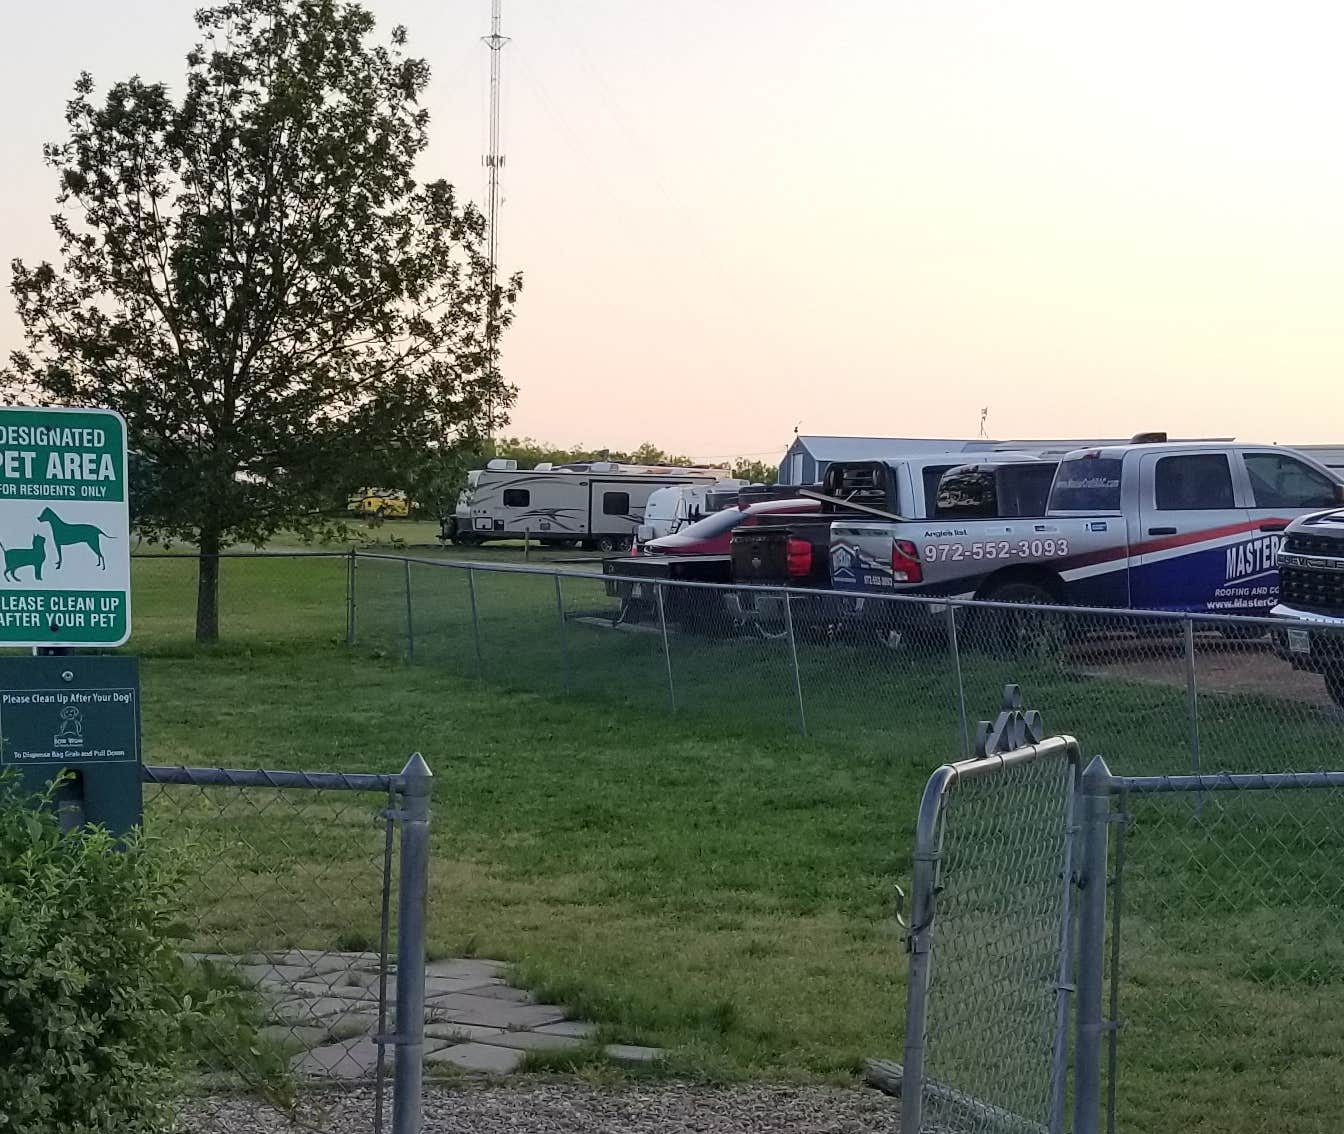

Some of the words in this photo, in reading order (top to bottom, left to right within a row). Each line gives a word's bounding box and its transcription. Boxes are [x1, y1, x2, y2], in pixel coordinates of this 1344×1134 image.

[46, 452, 116, 481] AREA
[20, 484, 76, 496] RESIDENTS
[81, 486, 106, 497] ONLY
[925, 539, 1068, 562] 972-552-3093
[1215, 587, 1249, 597] ROOFING
[1251, 587, 1267, 595] AND
[50, 597, 94, 611] CLEAN
[100, 597, 119, 611] UP
[45, 613, 85, 627] YOUR
[90, 613, 116, 627] PET
[3, 694, 30, 703] Please
[32, 694, 55, 703] Clean
[57, 694, 69, 704] Up
[70, 693, 91, 703] After
[93, 693, 111, 702] Your
[113, 693, 132, 703] Dog!
